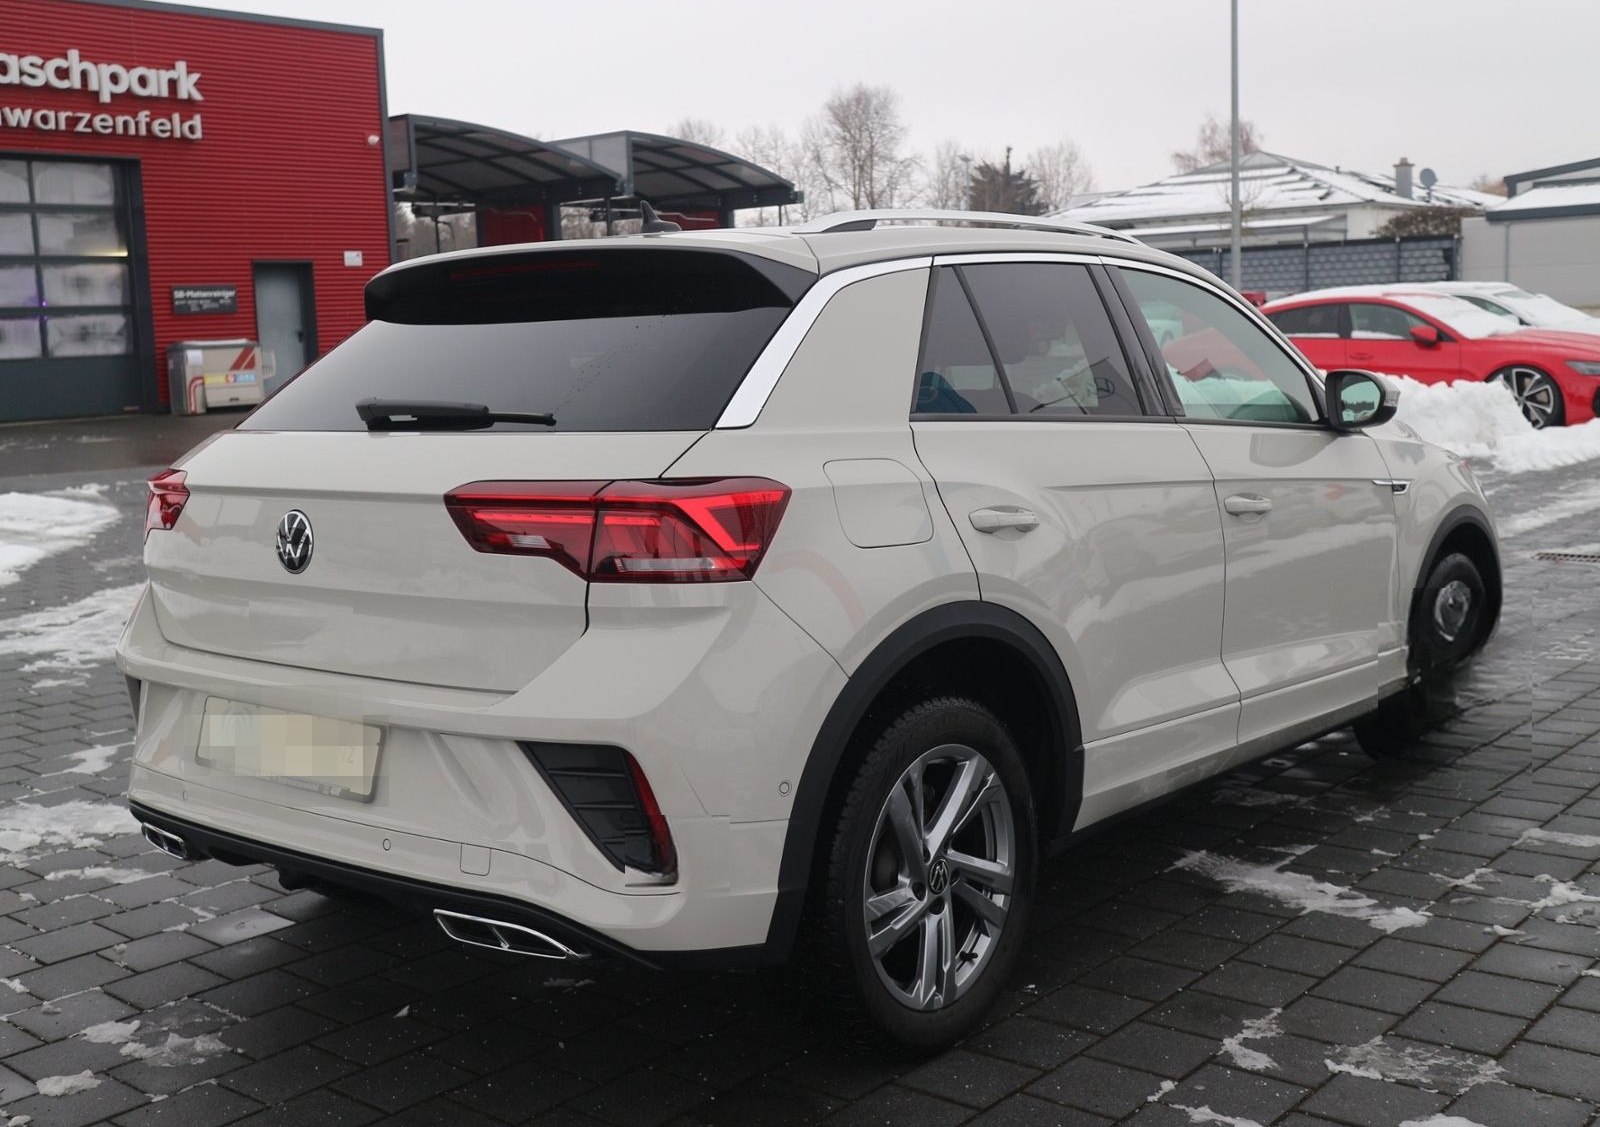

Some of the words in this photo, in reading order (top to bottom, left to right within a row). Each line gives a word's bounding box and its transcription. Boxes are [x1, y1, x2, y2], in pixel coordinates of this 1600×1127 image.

[0, 48, 204, 103] aschpark
[0, 106, 203, 140] warzenfeld
[277, 510, 313, 573] VW
